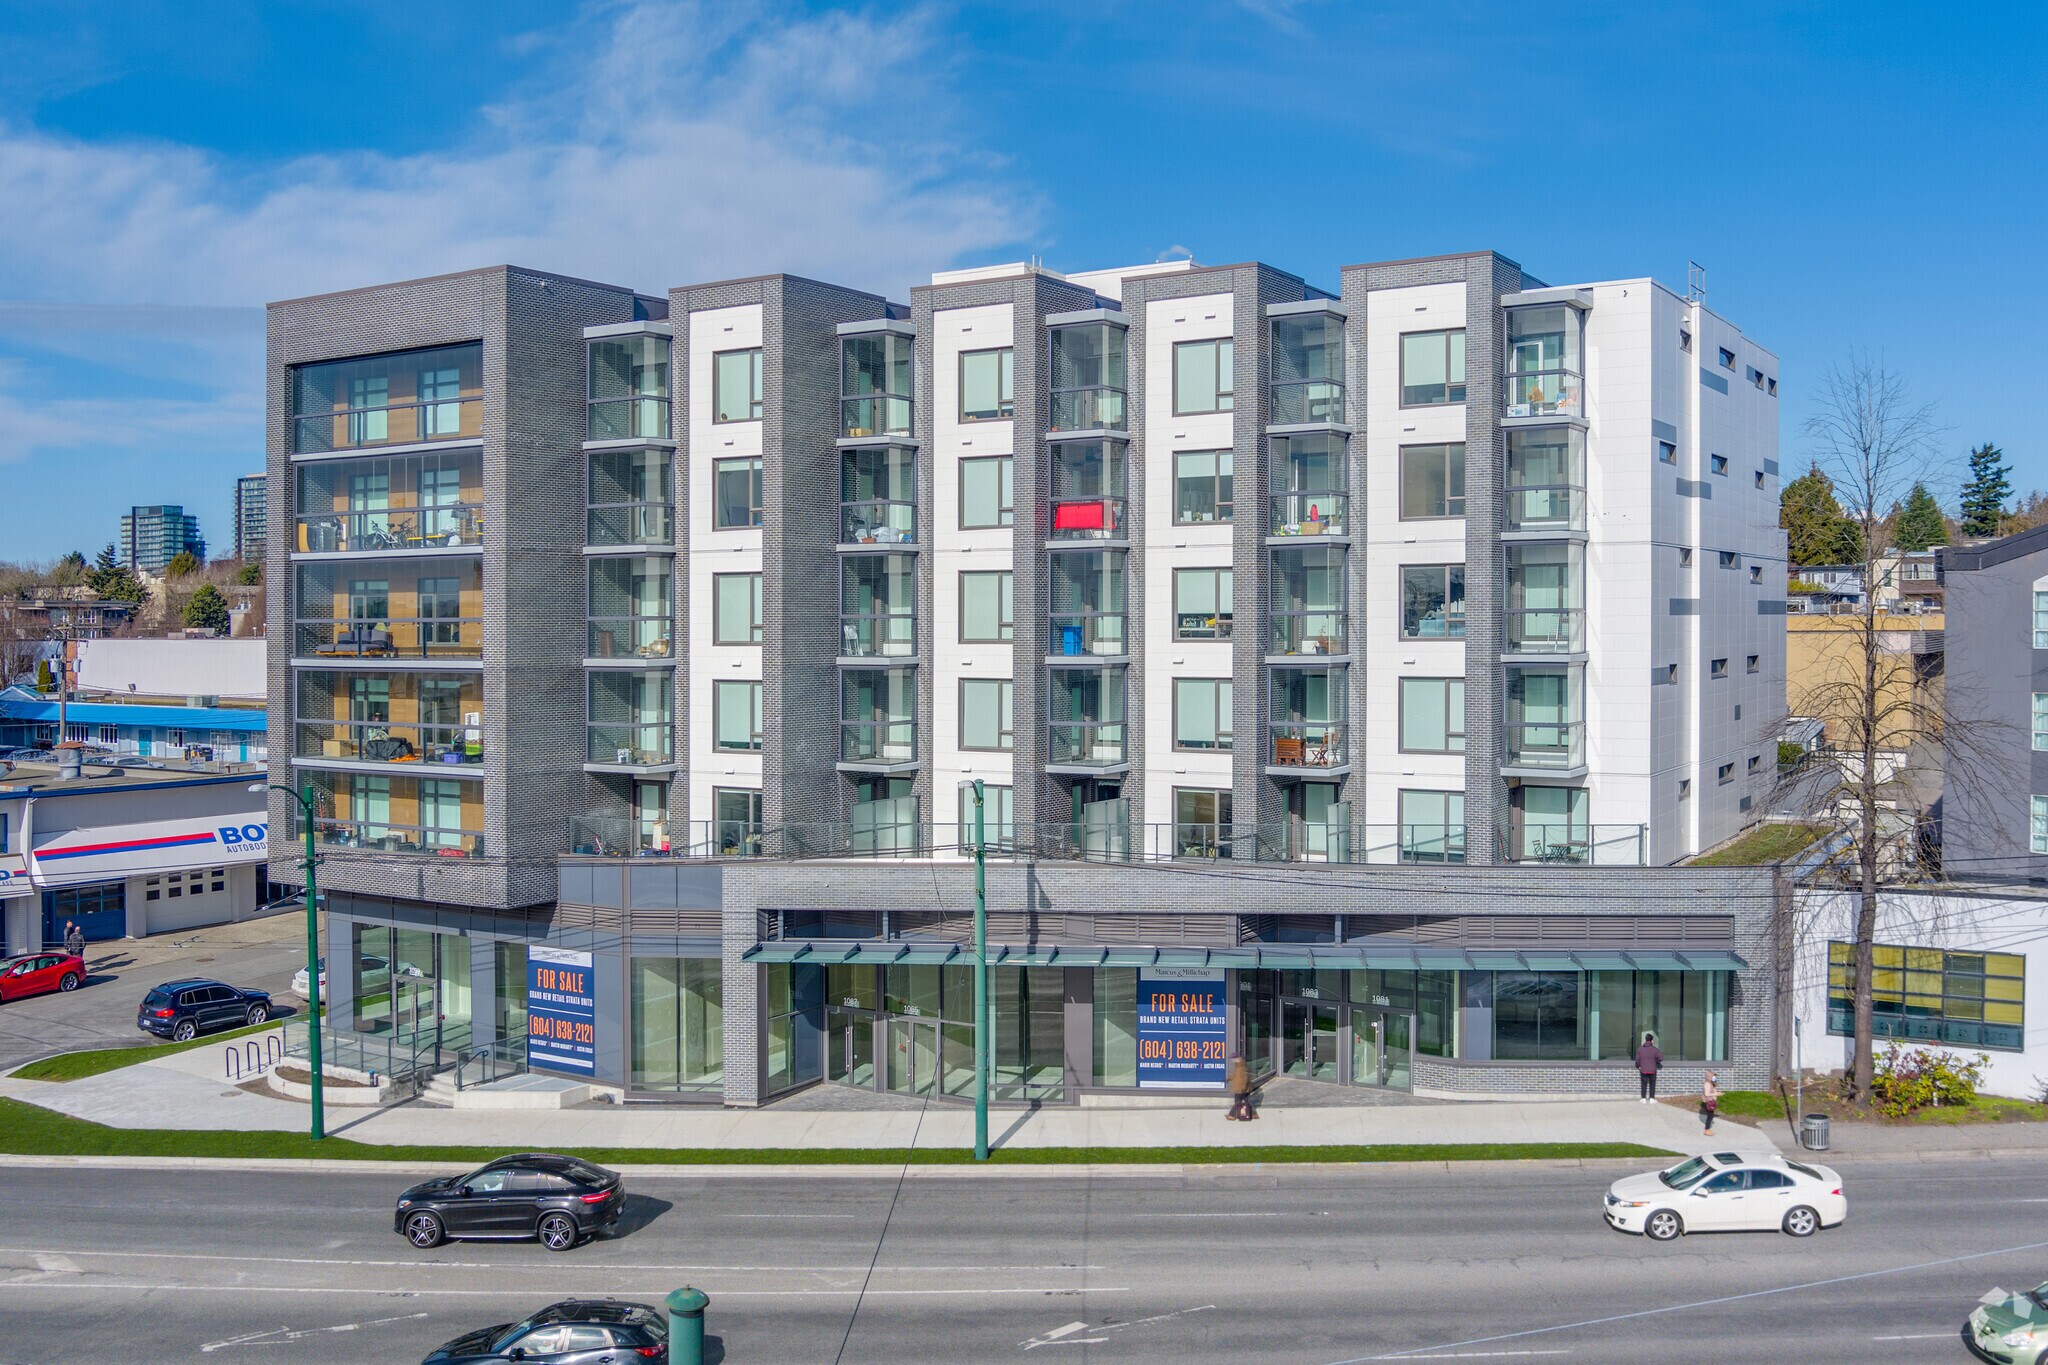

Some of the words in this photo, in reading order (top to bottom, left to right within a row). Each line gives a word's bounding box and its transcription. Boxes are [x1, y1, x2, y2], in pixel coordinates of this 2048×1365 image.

[218, 824, 268, 844] BO
[226, 842, 268, 853] AUTOBOD
[537, 968, 556, 990] FOR
[559, 972, 584, 994] SALE
[529, 990, 542, 999] BRAND
[542, 992, 551, 1001] NEW
[551, 993, 565, 1003] RETAIL
[565, 995, 580, 1005] STRATA
[581, 998, 593, 1007] UNITS
[843, 997, 858, 1005] 1087
[1151, 993, 1176, 1013] FOR
[1181, 993, 1213, 1013] SALE
[529, 1014, 554, 1039] (604)
[556, 1020, 593, 1044] 638-2121
[1140, 1015, 1157, 1024] BRAND
[1158, 1016, 1170, 1024] NEW
[1171, 1016, 1189, 1024] RETAIL
[1190, 1016, 1208, 1025] STRATA
[1210, 1016, 1226, 1025] UNITS
[1139, 1039, 1173, 1060] (604)
[1176, 1040, 1225, 1060] 638-2121
